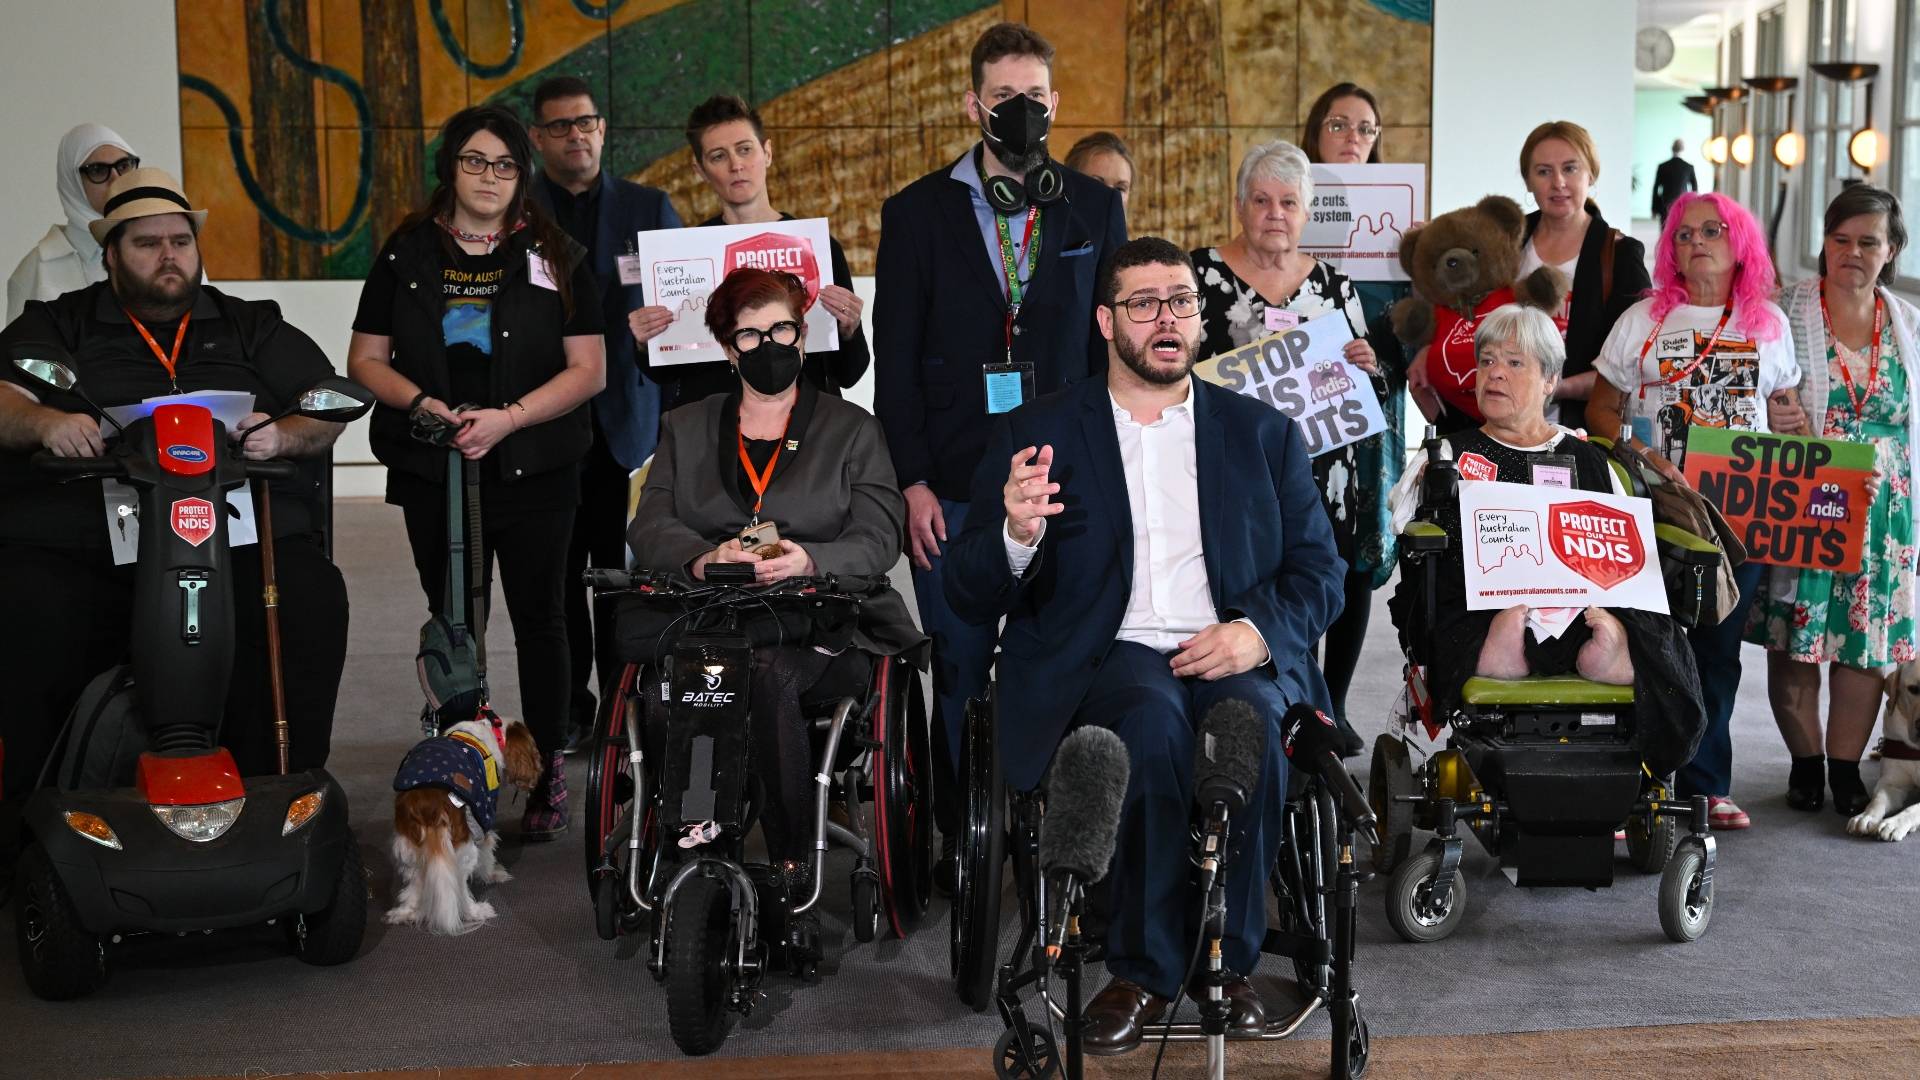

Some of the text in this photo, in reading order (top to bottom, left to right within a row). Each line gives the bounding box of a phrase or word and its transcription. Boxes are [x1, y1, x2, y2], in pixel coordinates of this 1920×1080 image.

[1322, 194, 1348, 207] cuts.
[1313, 210, 1355, 223] system.
[735, 247, 803, 269] PROTECT
[444, 269, 472, 282] FROM
[656, 265, 684, 277] Every
[463, 285, 499, 296] ADHDER
[660, 286, 690, 298] Counts
[1662, 337, 1689, 346] Guide
[1663, 344, 1687, 352] Dogs.
[1216, 329, 1310, 392] STOP
[1315, 375, 1349, 399] ndis
[1728, 435, 1832, 480] STOP
[1466, 456, 1493, 473] PROTECT
[1462, 462, 1489, 481] NDIS
[1698, 470, 1800, 522] NDIS
[178, 506, 209, 515] PROTECT
[1810, 501, 1844, 518] ndis
[178, 518, 210, 530] NDIS
[1478, 513, 1507, 524] Every
[1559, 511, 1626, 537] PROTECT
[1480, 523, 1531, 533] Australian
[1480, 535, 1514, 544] Counts
[1586, 531, 1605, 540] OUR
[1563, 534, 1633, 564] NDIS
[1744, 520, 1847, 567] CUTS
[1478, 587, 1588, 597] www.everyaustraliancounts.com.au
[681, 691, 736, 703] BATEC
